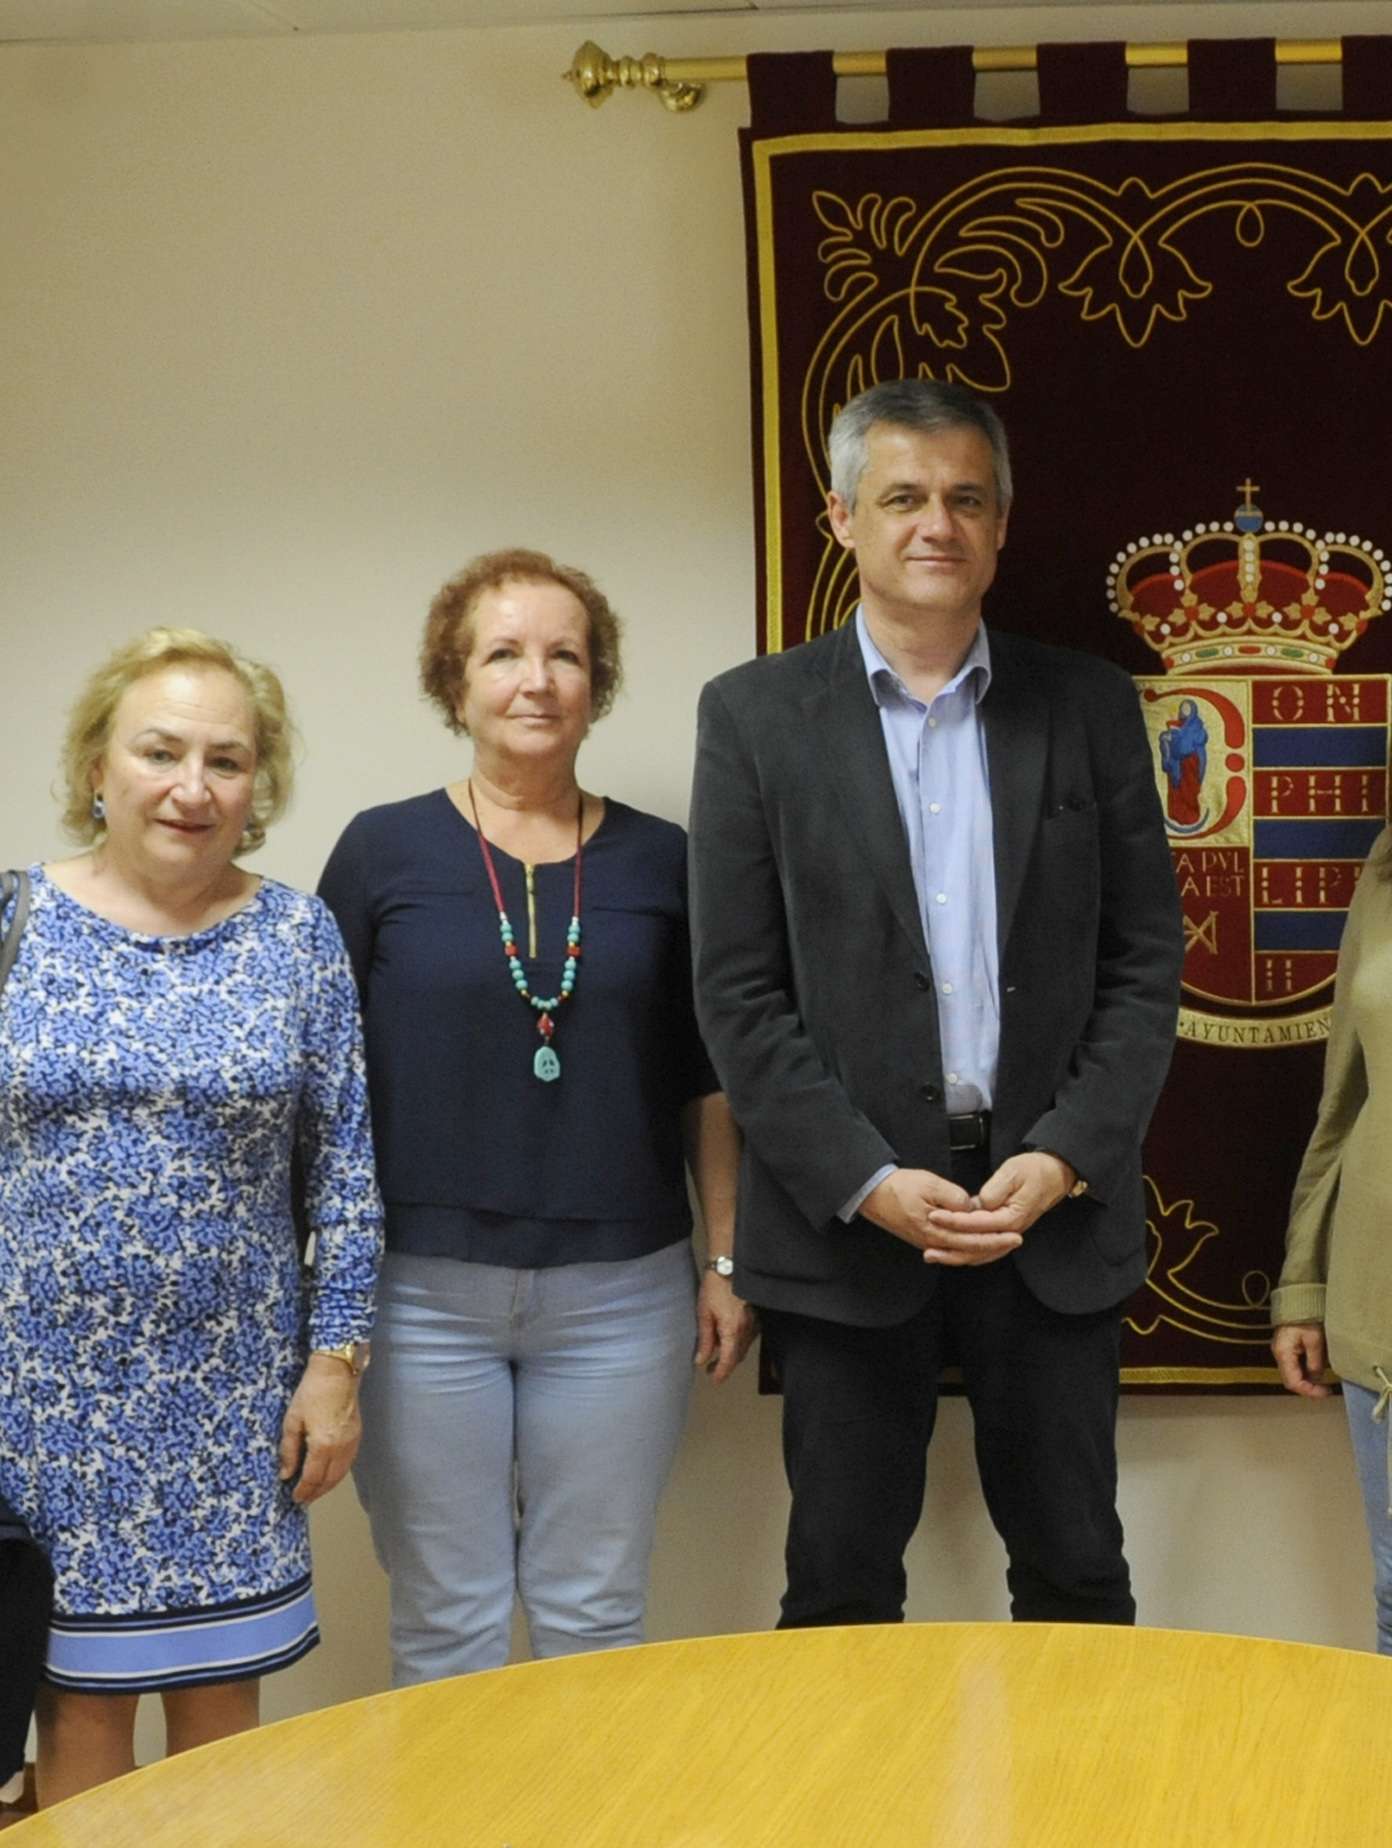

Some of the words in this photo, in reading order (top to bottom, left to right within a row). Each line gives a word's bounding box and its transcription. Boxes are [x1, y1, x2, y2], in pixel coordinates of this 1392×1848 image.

[1271, 682, 1361, 723] ON
[1270, 774, 1371, 814] PHI
[1185, 1016, 1331, 1043] AYUNTAMIEN
